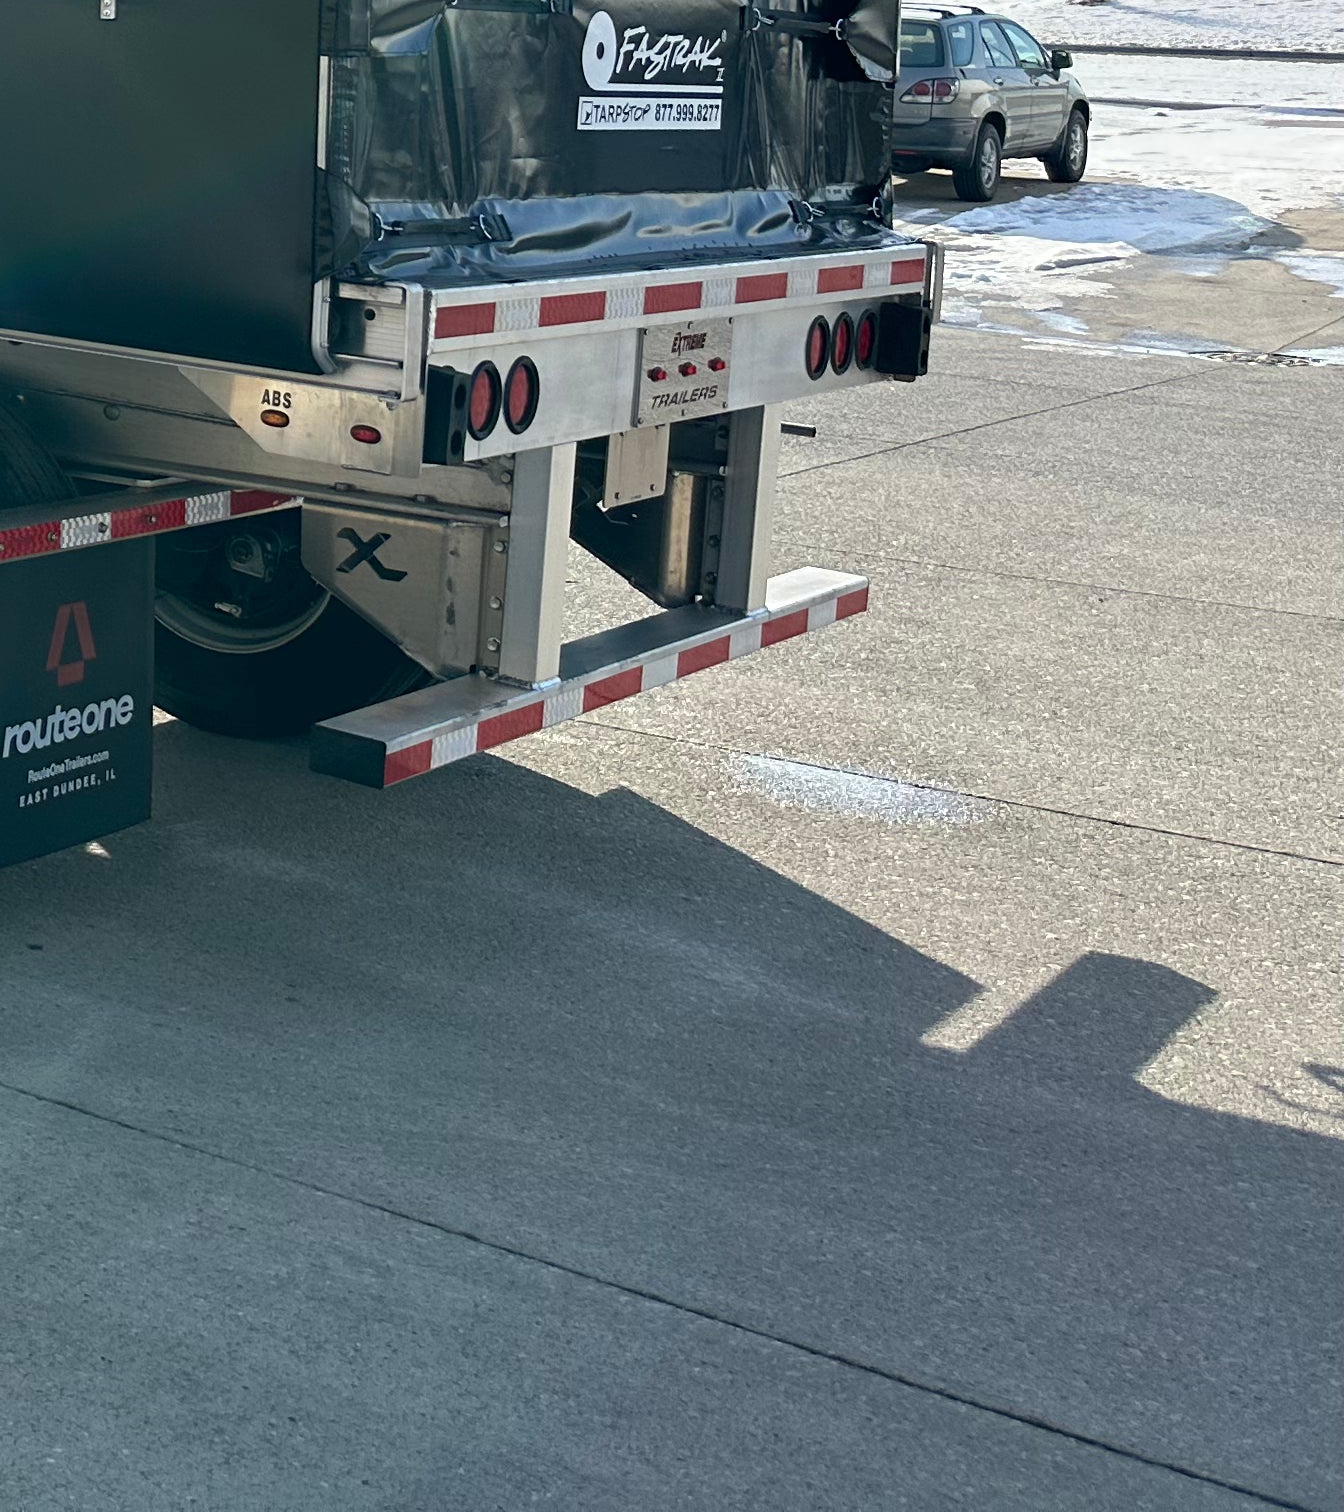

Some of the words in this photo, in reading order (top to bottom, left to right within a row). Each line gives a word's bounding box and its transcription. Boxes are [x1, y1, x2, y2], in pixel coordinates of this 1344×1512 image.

[615, 26, 722, 80] FASTRAK
[593, 102, 651, 123] TARPSTOP
[654, 103, 720, 122] 877.999.8277
[671, 332, 708, 356] EXTREME
[261, 388, 292, 409] ABS
[651, 385, 718, 410] TRAILERS
[2, 694, 135, 758] routeone
[19, 788, 49, 808] EAST
[53, 773, 101, 798] DUNDEE,
[105, 768, 116, 782] IL
